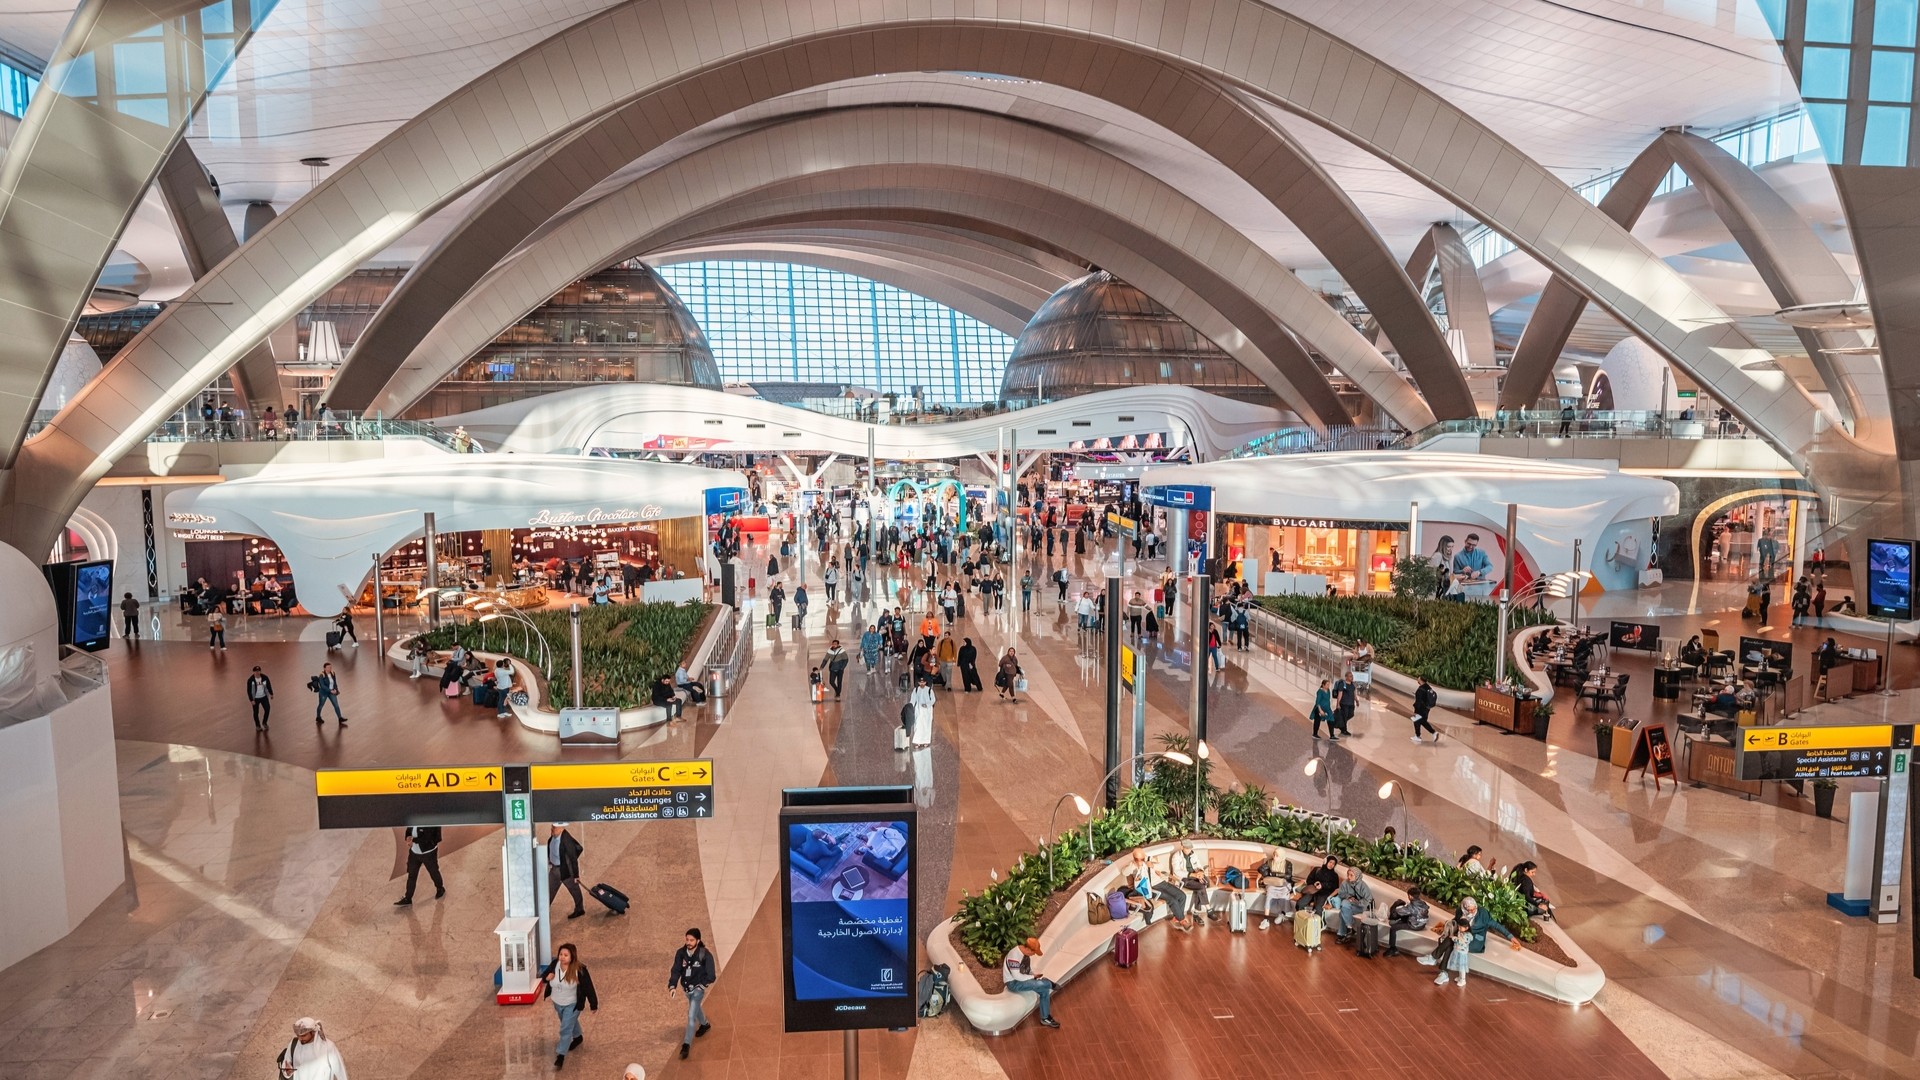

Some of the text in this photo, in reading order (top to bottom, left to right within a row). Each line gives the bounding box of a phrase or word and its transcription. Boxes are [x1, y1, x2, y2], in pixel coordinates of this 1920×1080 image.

[528, 510, 585, 525] Butlers
[587, 508, 638, 522] Chocolate
[1273, 519, 1333, 527] BVLGARI
[1479, 699, 1511, 714] BOTTEGA
[1778, 733, 1788, 745] B
[658, 767, 670, 781] C
[640, 797, 672, 805] Lounges
[818, 928, 850, 938] الخارجية
